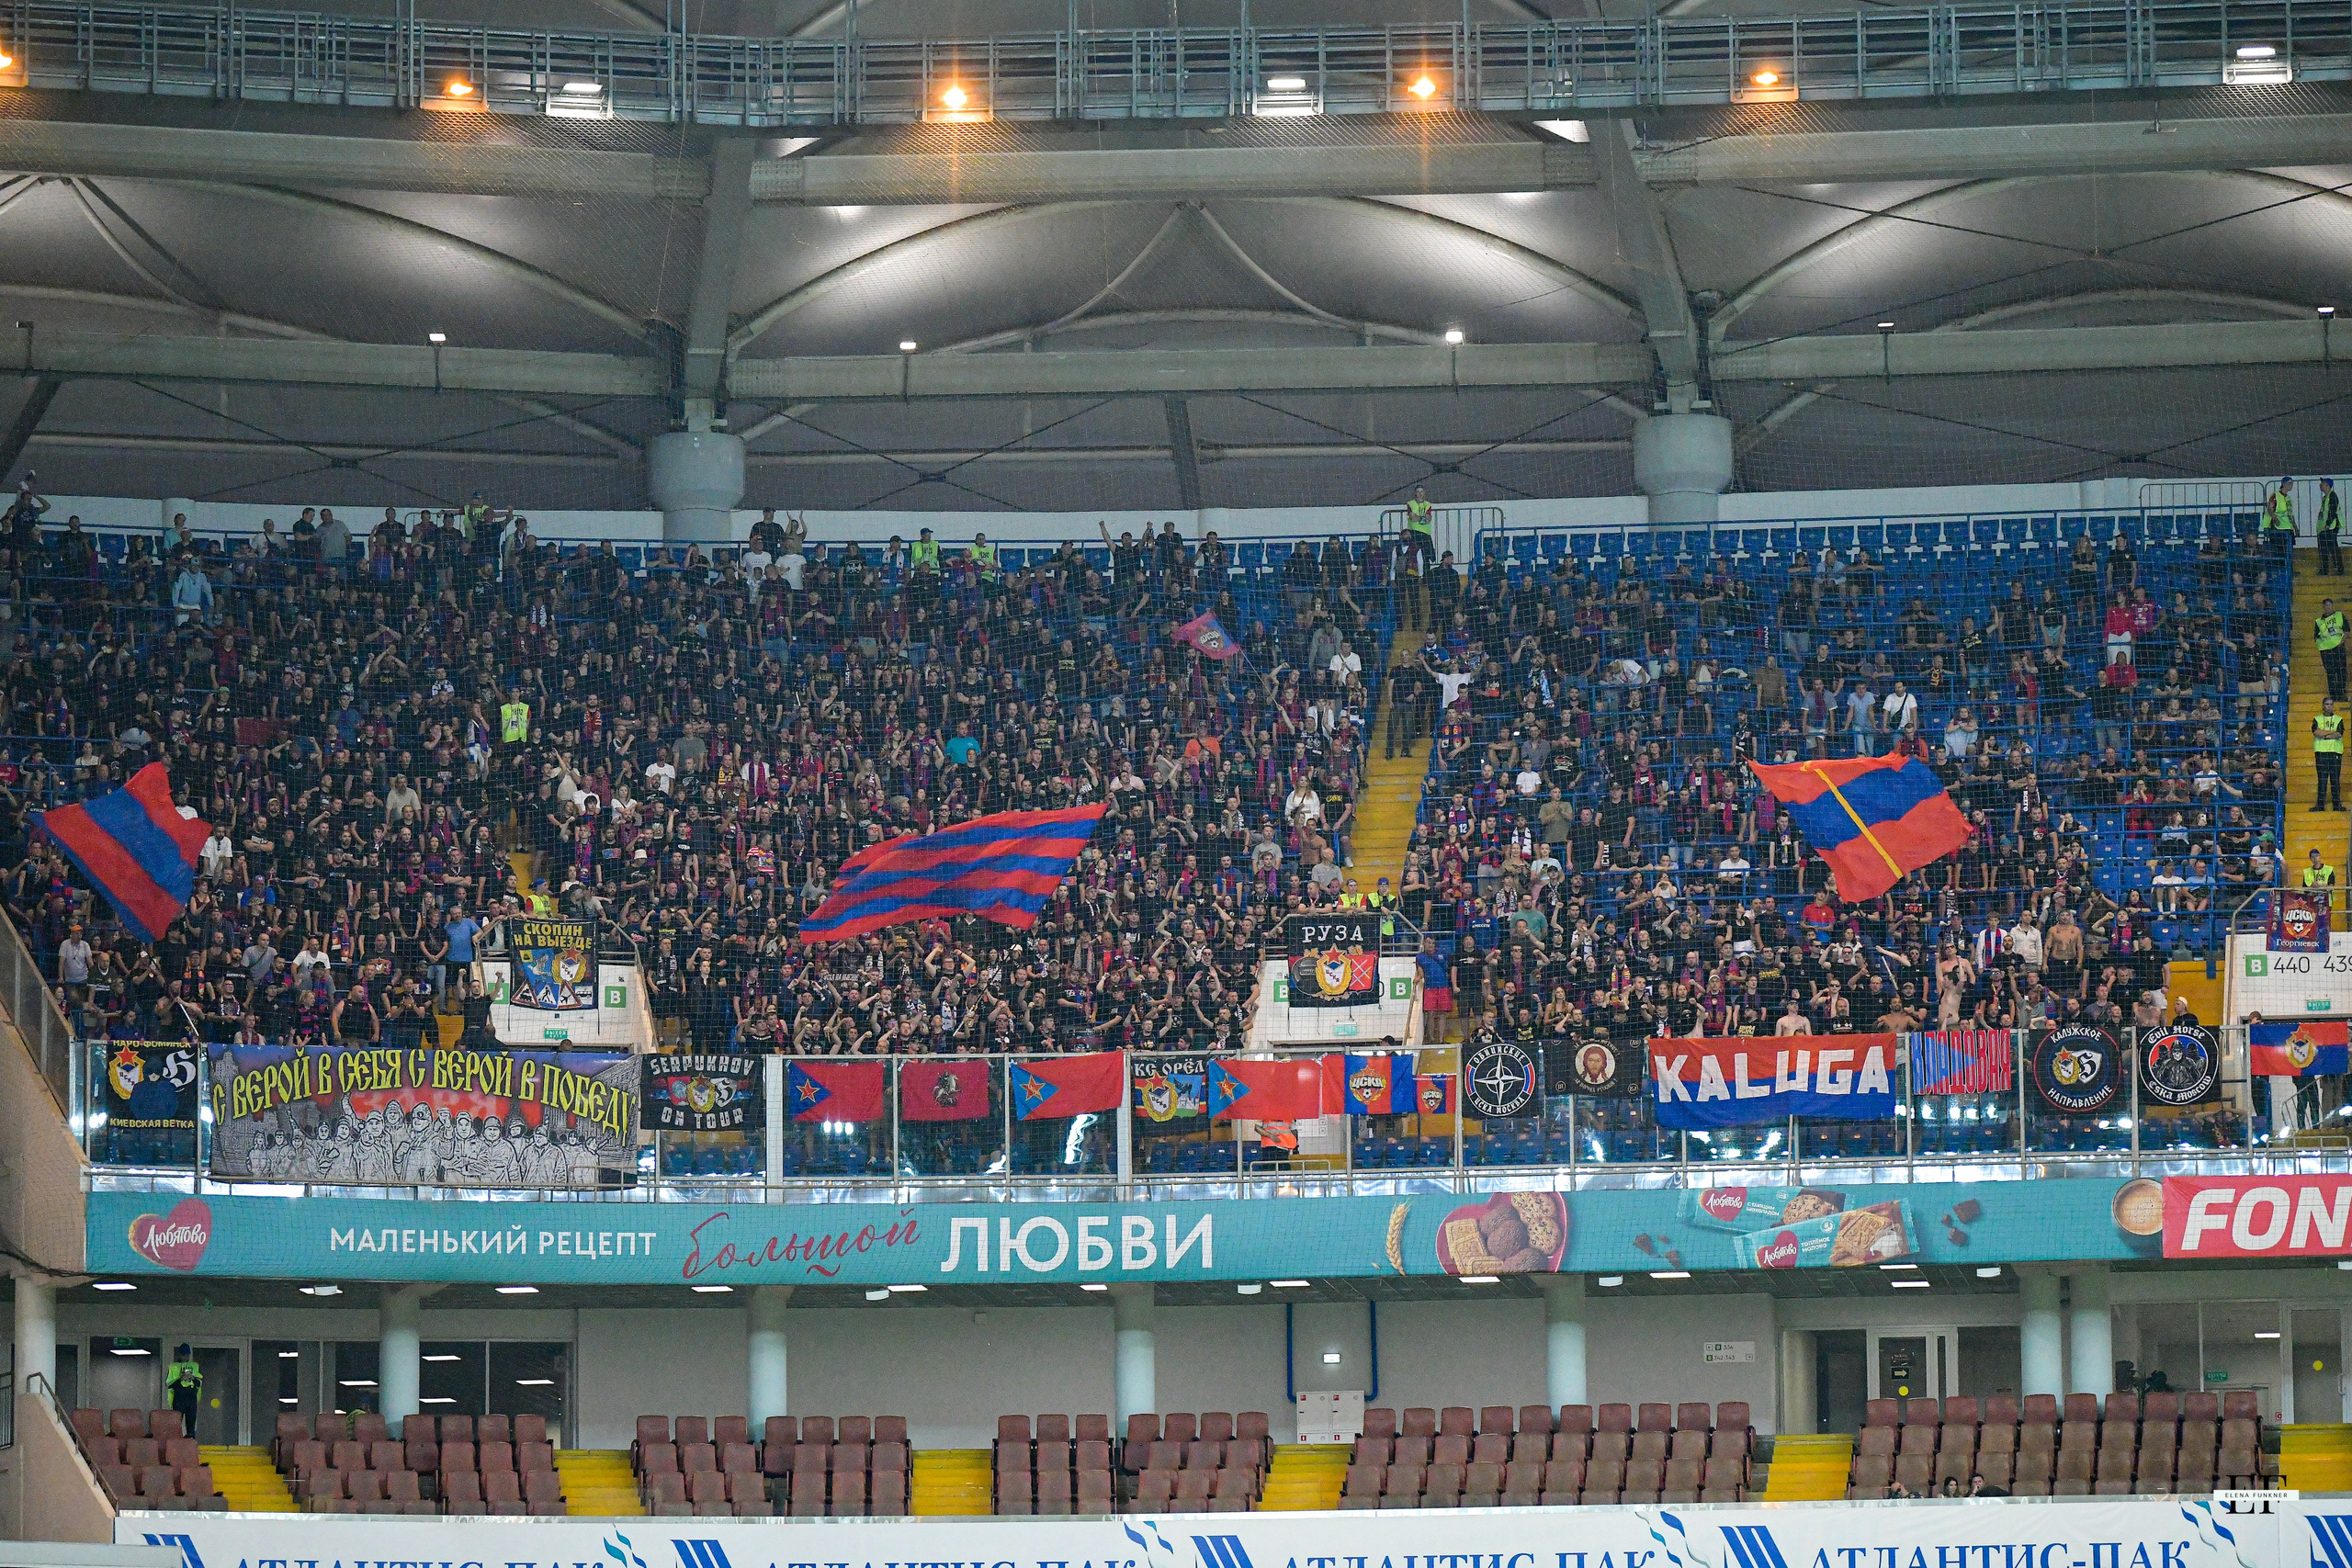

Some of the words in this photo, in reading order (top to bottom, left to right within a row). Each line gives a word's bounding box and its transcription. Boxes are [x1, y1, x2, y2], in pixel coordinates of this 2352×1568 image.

[1459, 823, 1467, 833] 12
[2285, 909, 2313, 922] ЦСКА
[524, 923, 582, 935] СКОПИН
[1302, 925, 1363, 943] РУЗА
[514, 934, 533, 946] НА
[537, 934, 593, 950] ВЫЕЗДЕ
[2276, 939, 2320, 948] Георгиевск
[2274, 956, 2310, 974] 440
[2050, 1026, 2102, 1043] КАЛУЖСКОЕ
[2148, 1026, 2168, 1044] Evil
[2173, 1025, 2205, 1039] Horse
[650, 1055, 754, 1076] SERPUKHOV
[1162, 1058, 1204, 1075] ОРЁЛ
[1911, 1029, 2011, 1095] КЛАДОВАЯ
[1351, 1077, 1383, 1089] ЦСКА
[1655, 1045, 1889, 1102] KALUGA
[213, 1084, 226, 1126] С
[232, 1048, 311, 1120] ВЕРОЙ
[318, 1053, 332, 1095] В
[338, 1050, 402, 1093] СЕБЯ
[409, 1049, 425, 1088] С
[432, 1049, 514, 1097] ВЕРОЙ
[519, 1059, 536, 1100] В
[540, 1064, 636, 1147] ПОБЕДУ
[1474, 1098, 1492, 1113] ЦСКА
[1496, 1096, 1525, 1114] МОСКВА
[2047, 1085, 2112, 1108] НАПРАВЛЕНИЕ
[110, 1118, 161, 1128] КИЕВСКАЯ
[163, 1119, 195, 1128] ВЕТКА
[662, 1106, 684, 1126] ON
[695, 1107, 744, 1129] TOUR
[1706, 1193, 1743, 1213] Любятово
[2181, 1186, 2352, 1251] FON
[142, 1223, 207, 1259] Любятово
[331, 1225, 527, 1255] МАЛЕНЬКИЙ
[539, 1228, 657, 1259] РЕЦЕПТ
[941, 1213, 1214, 1273] ЛЮБВИ
[1763, 1244, 1797, 1267] Любятово
